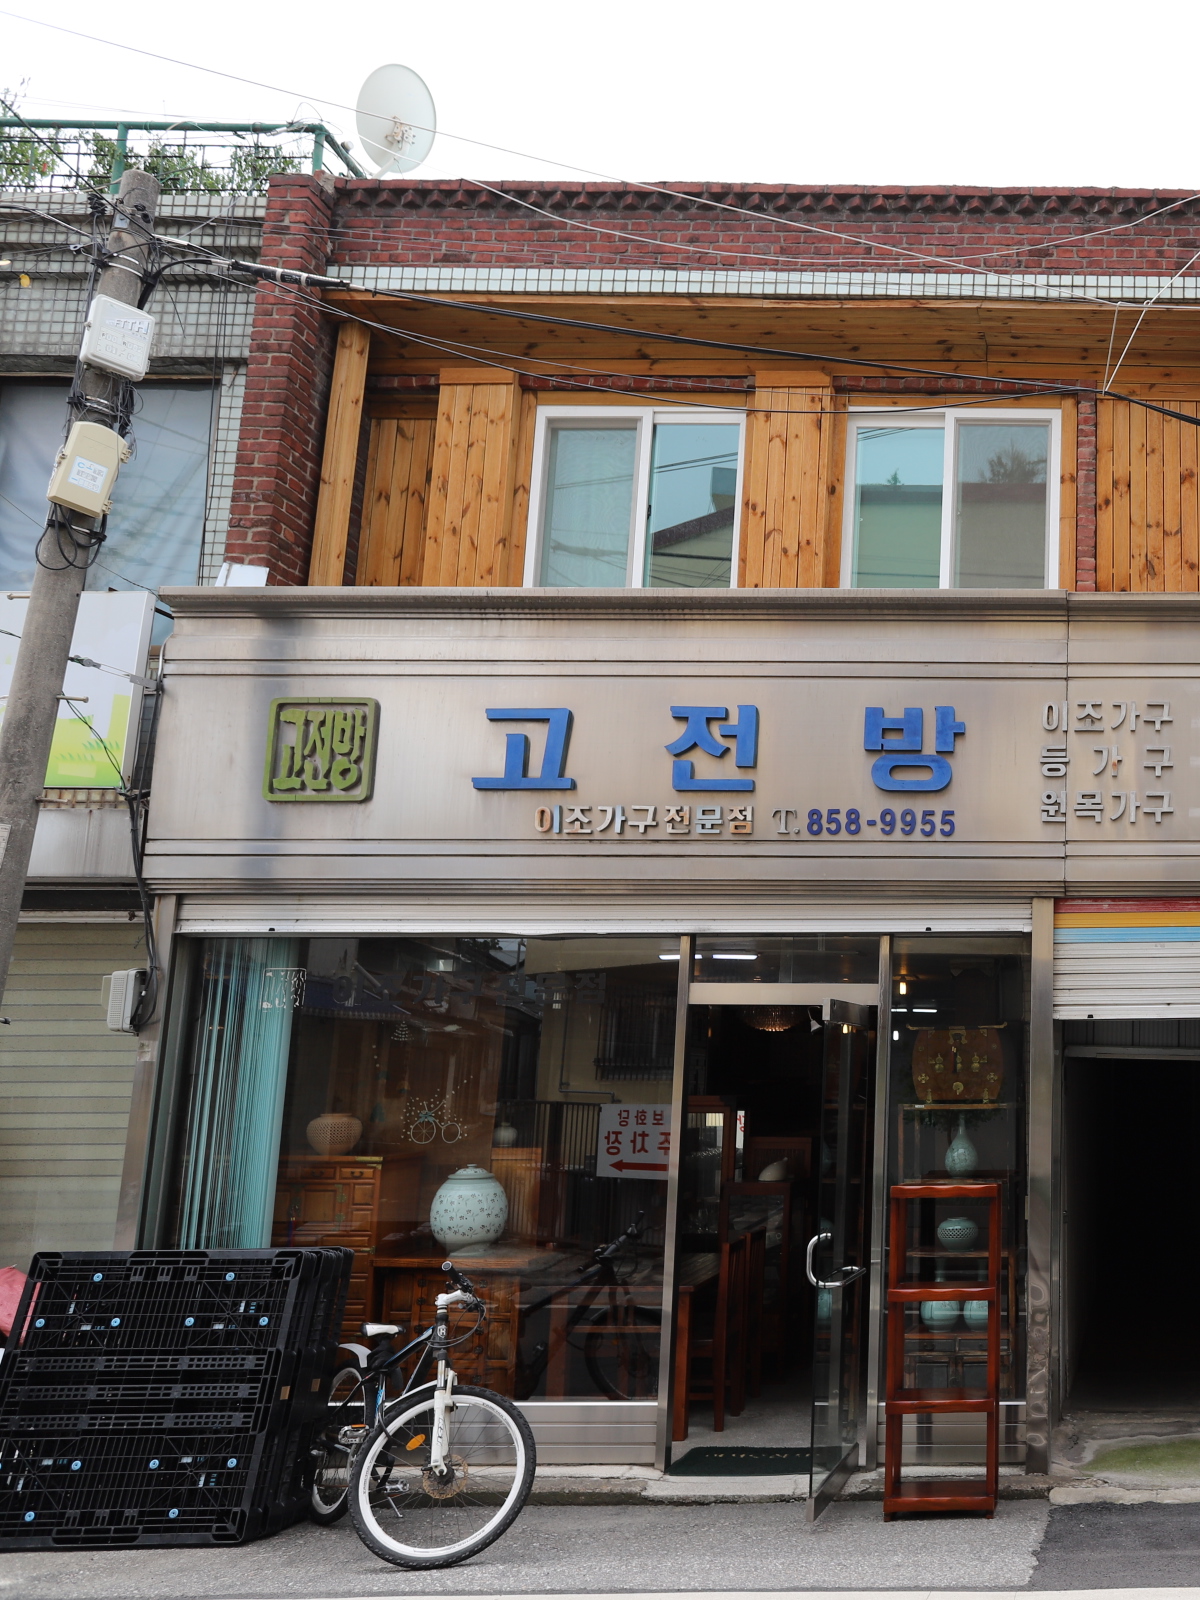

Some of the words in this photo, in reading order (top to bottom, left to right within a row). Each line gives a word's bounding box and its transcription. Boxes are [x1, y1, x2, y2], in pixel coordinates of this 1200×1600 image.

[1042, 700, 1174, 732] 이조가구
[272, 706, 366, 791] 고전방
[534, 804, 754, 835] 이조가구전문점
[1041, 790, 1174, 823] 원목가구
